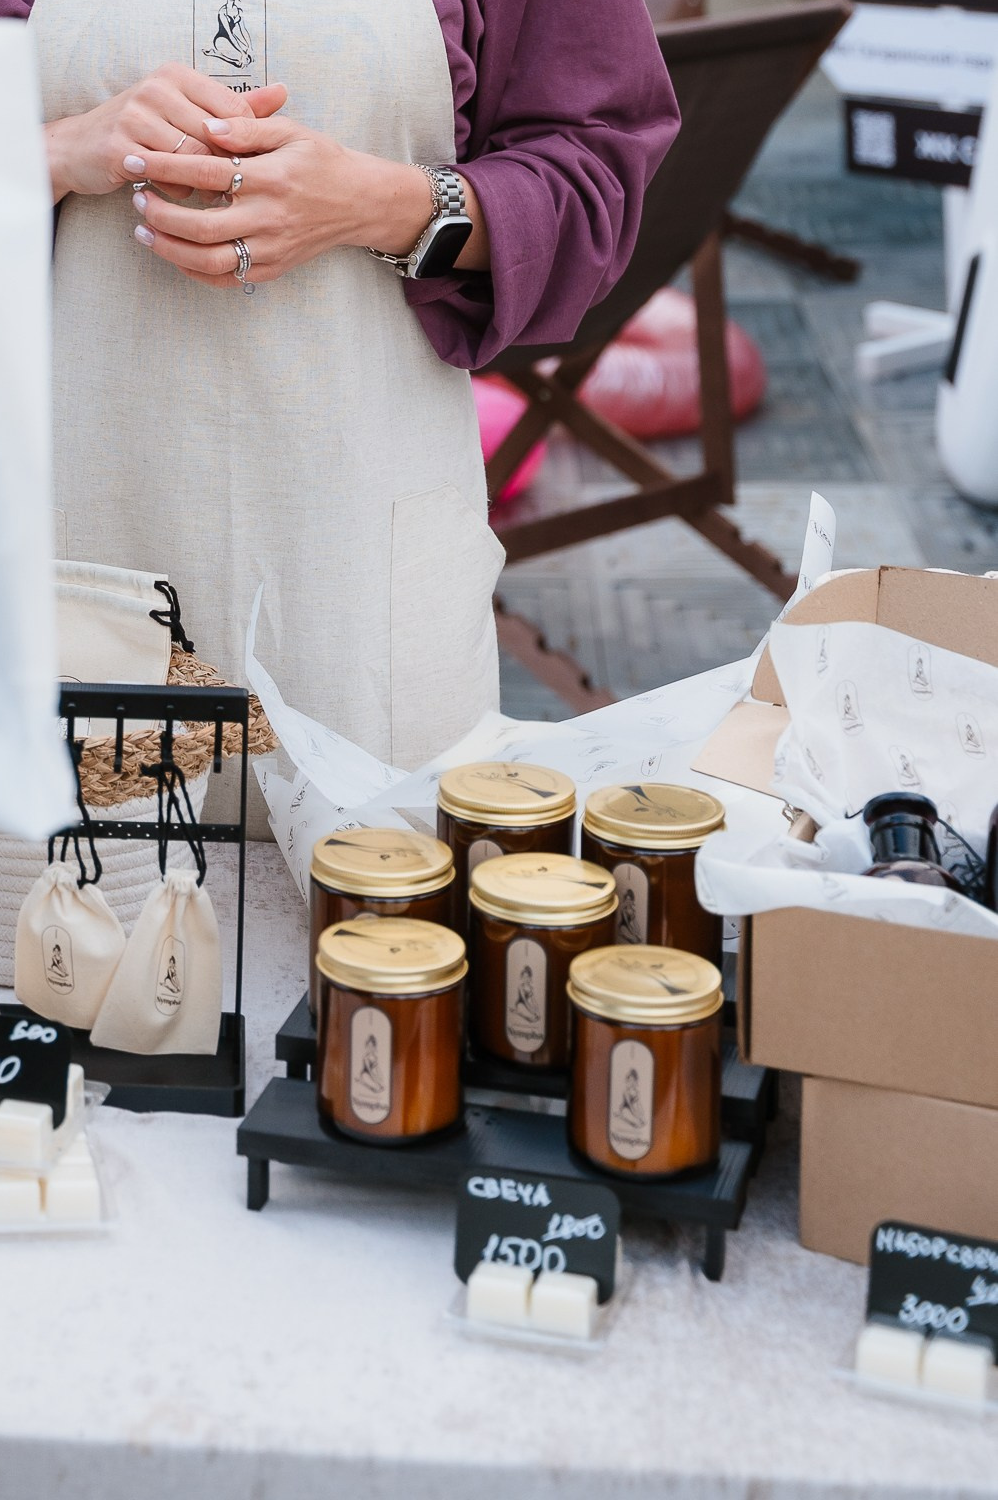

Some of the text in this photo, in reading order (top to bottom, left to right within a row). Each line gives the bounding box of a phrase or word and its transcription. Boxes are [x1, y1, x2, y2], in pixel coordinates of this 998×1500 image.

[467, 1176, 552, 1207] СВЕЧА
[482, 1233, 567, 1273] 1500
[898, 1293, 969, 1334] 3000
